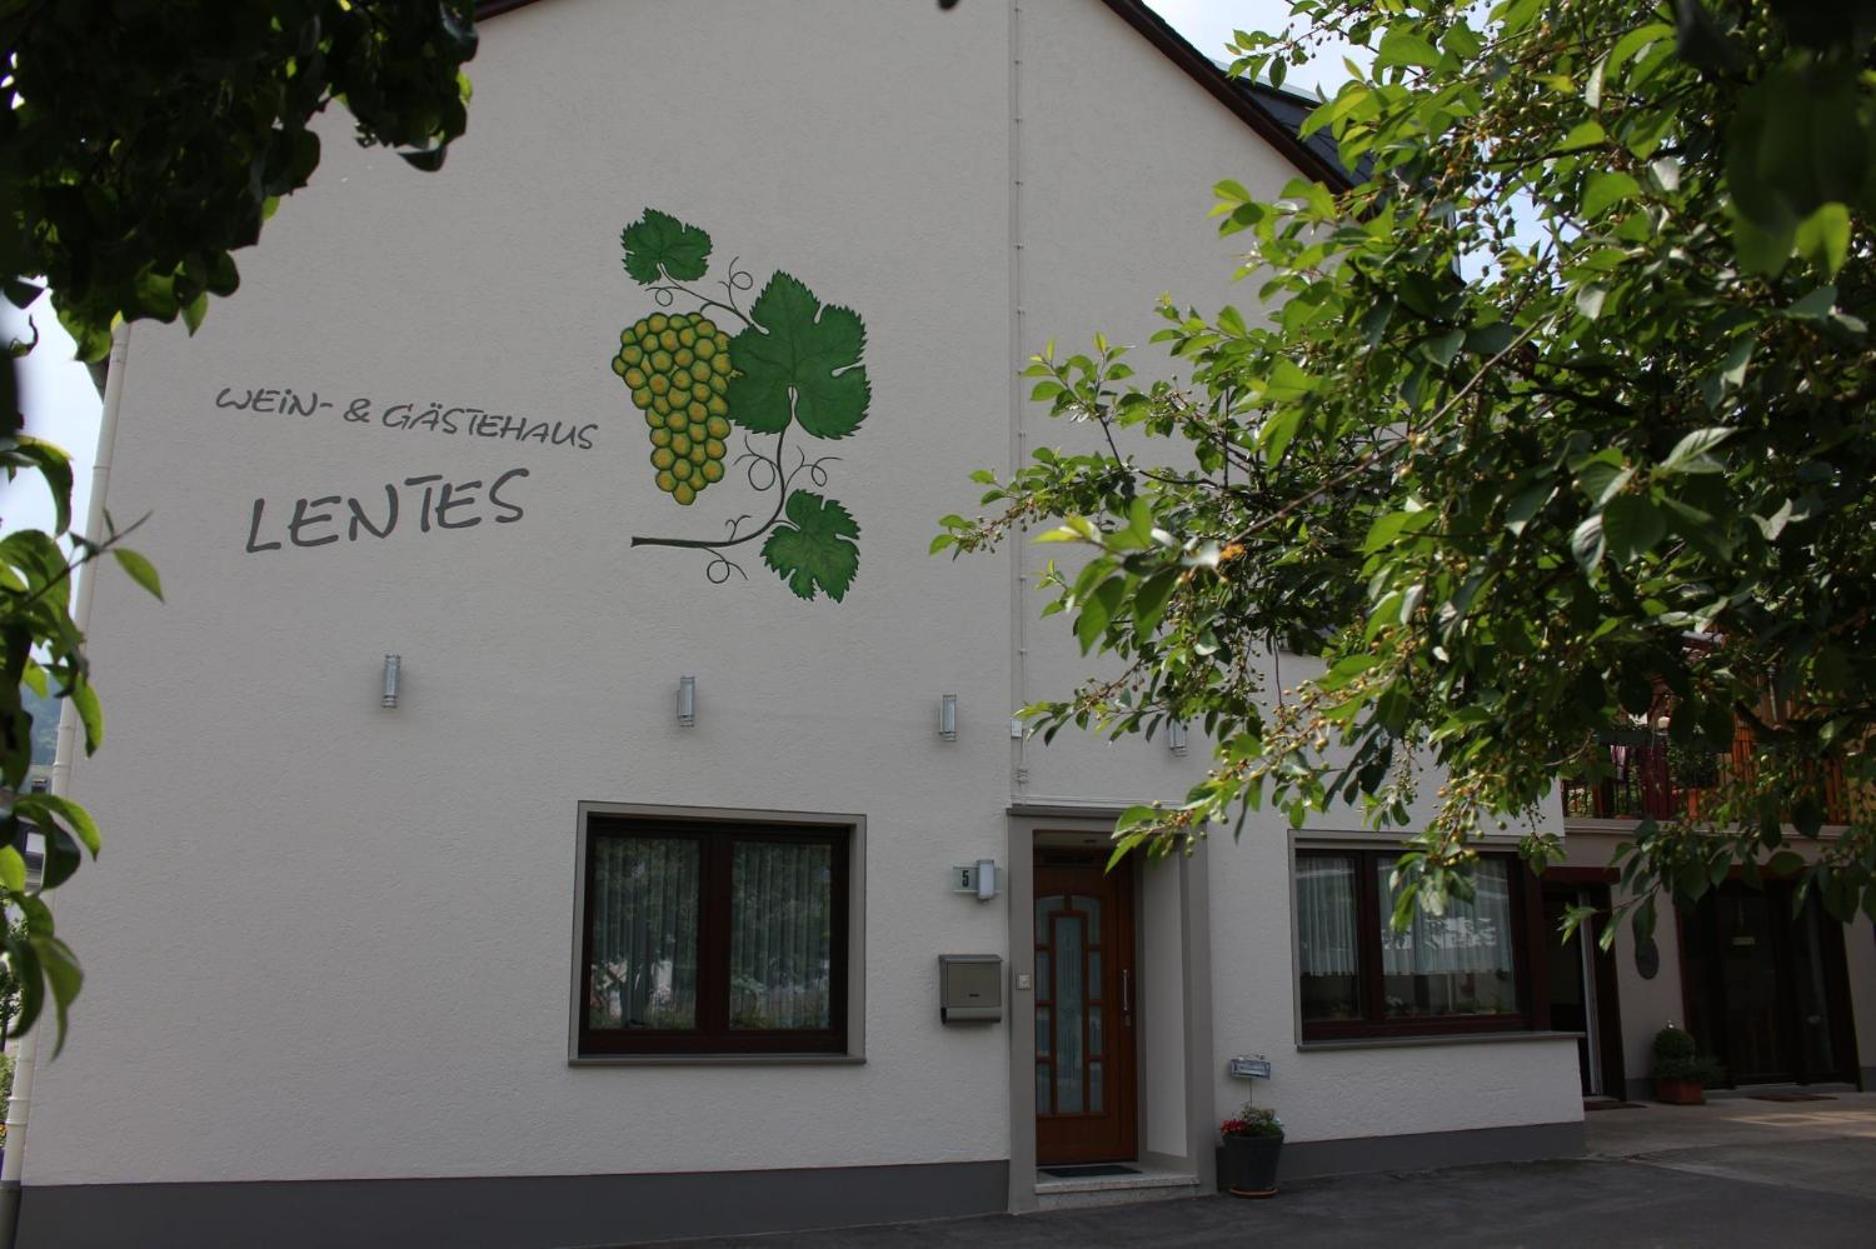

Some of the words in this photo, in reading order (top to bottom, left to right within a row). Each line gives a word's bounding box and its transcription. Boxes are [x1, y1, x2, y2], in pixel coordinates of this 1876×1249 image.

[343, 398, 371, 423] &
[382, 402, 599, 450] GÄSTEHAUS
[245, 467, 530, 554] LENTES
[962, 869, 970, 888] 5
